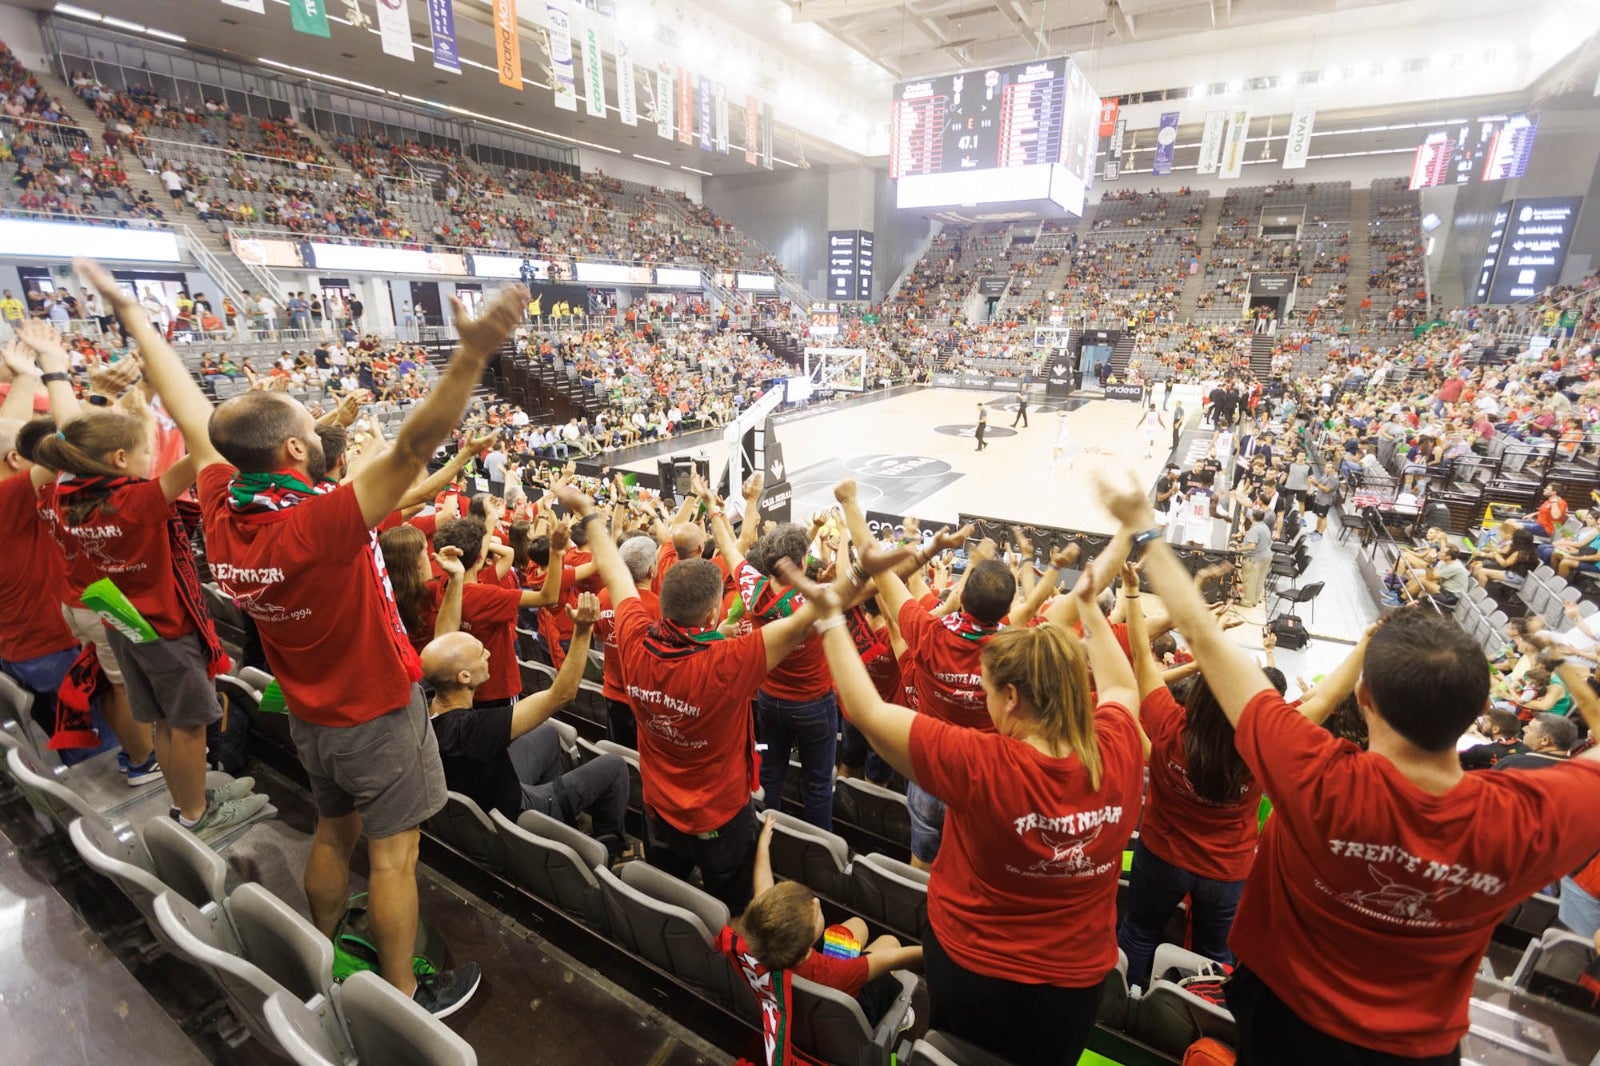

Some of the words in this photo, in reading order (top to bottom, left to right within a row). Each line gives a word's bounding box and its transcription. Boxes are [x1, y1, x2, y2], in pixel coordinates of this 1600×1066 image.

[701, 80, 711, 147] PULEVA
[1293, 114, 1309, 153] OLIVA
[1105, 385, 1141, 395] endesa
[291, 608, 312, 621] 1994
[1014, 812, 1075, 835] FRENTE
[1329, 839, 1421, 873] FRENTE
